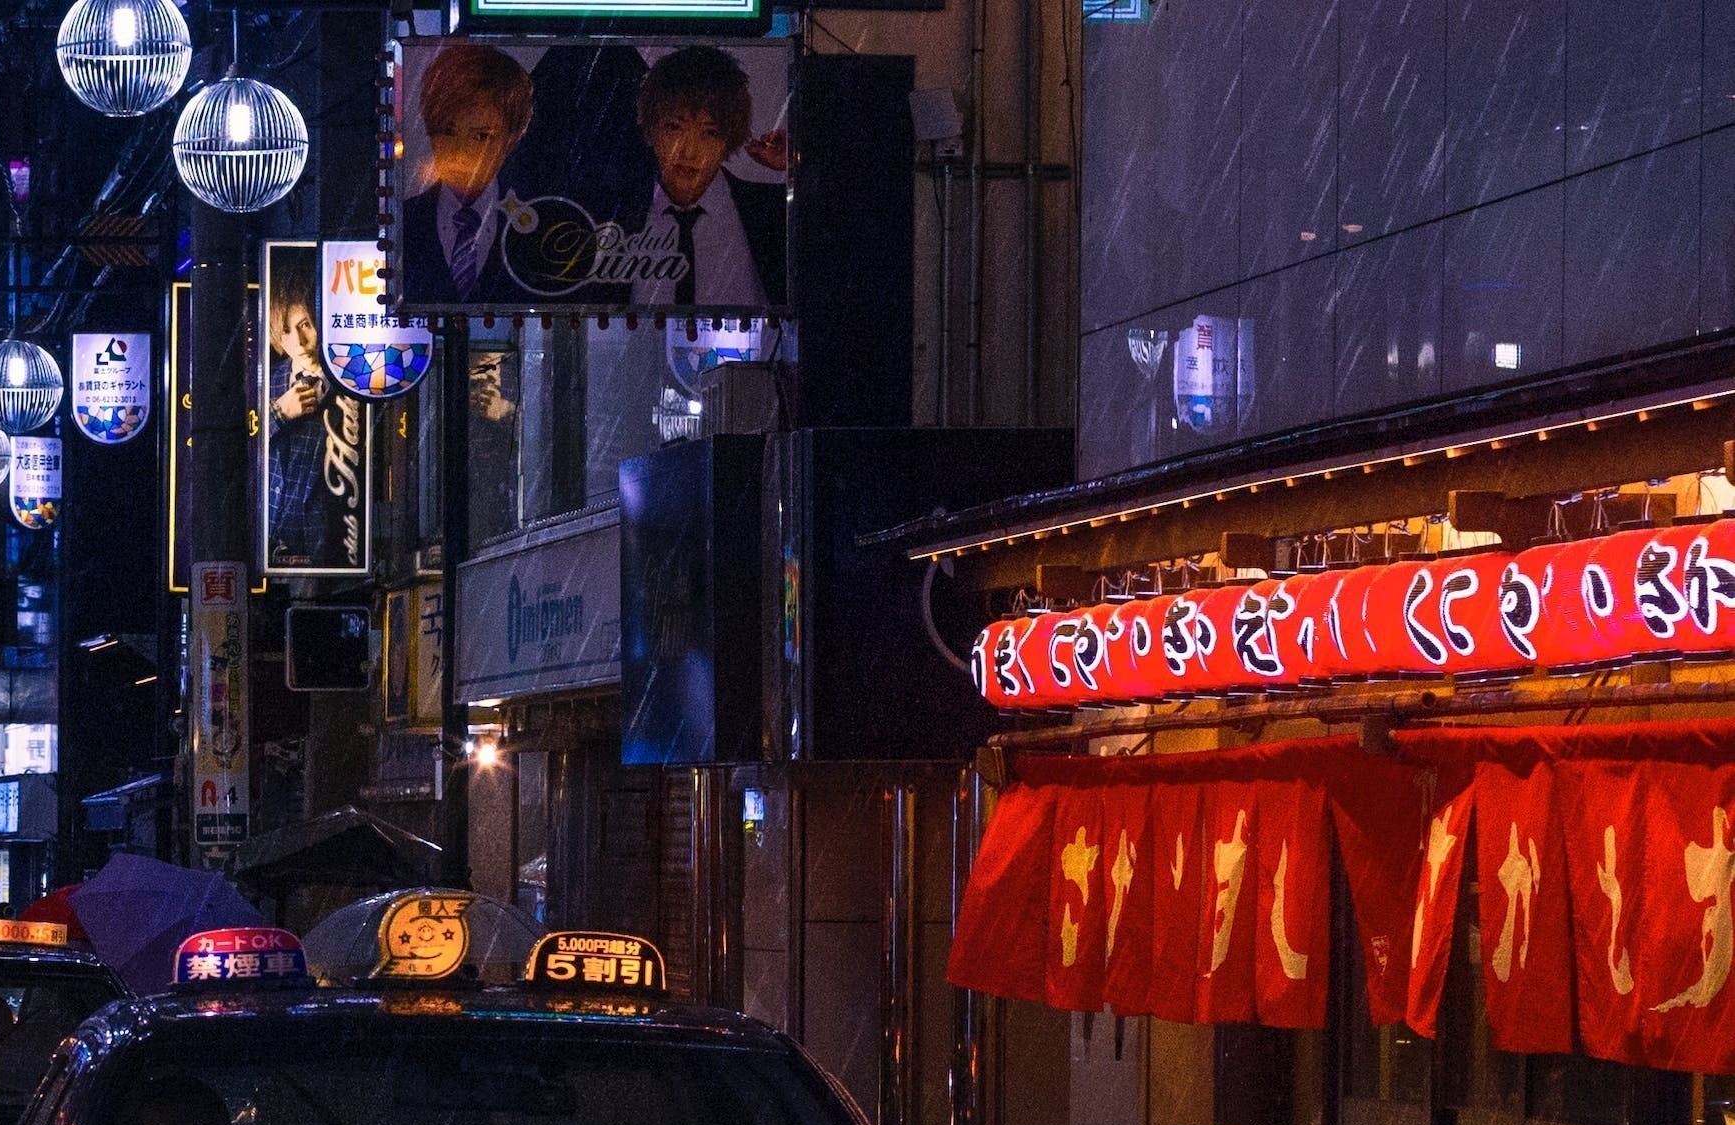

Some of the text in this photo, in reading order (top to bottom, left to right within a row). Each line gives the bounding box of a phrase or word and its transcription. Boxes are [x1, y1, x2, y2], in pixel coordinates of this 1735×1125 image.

[331, 259, 386, 295] パピ
[186, 951, 299, 980] 禁煙車
[546, 953, 653, 986] 5割引
